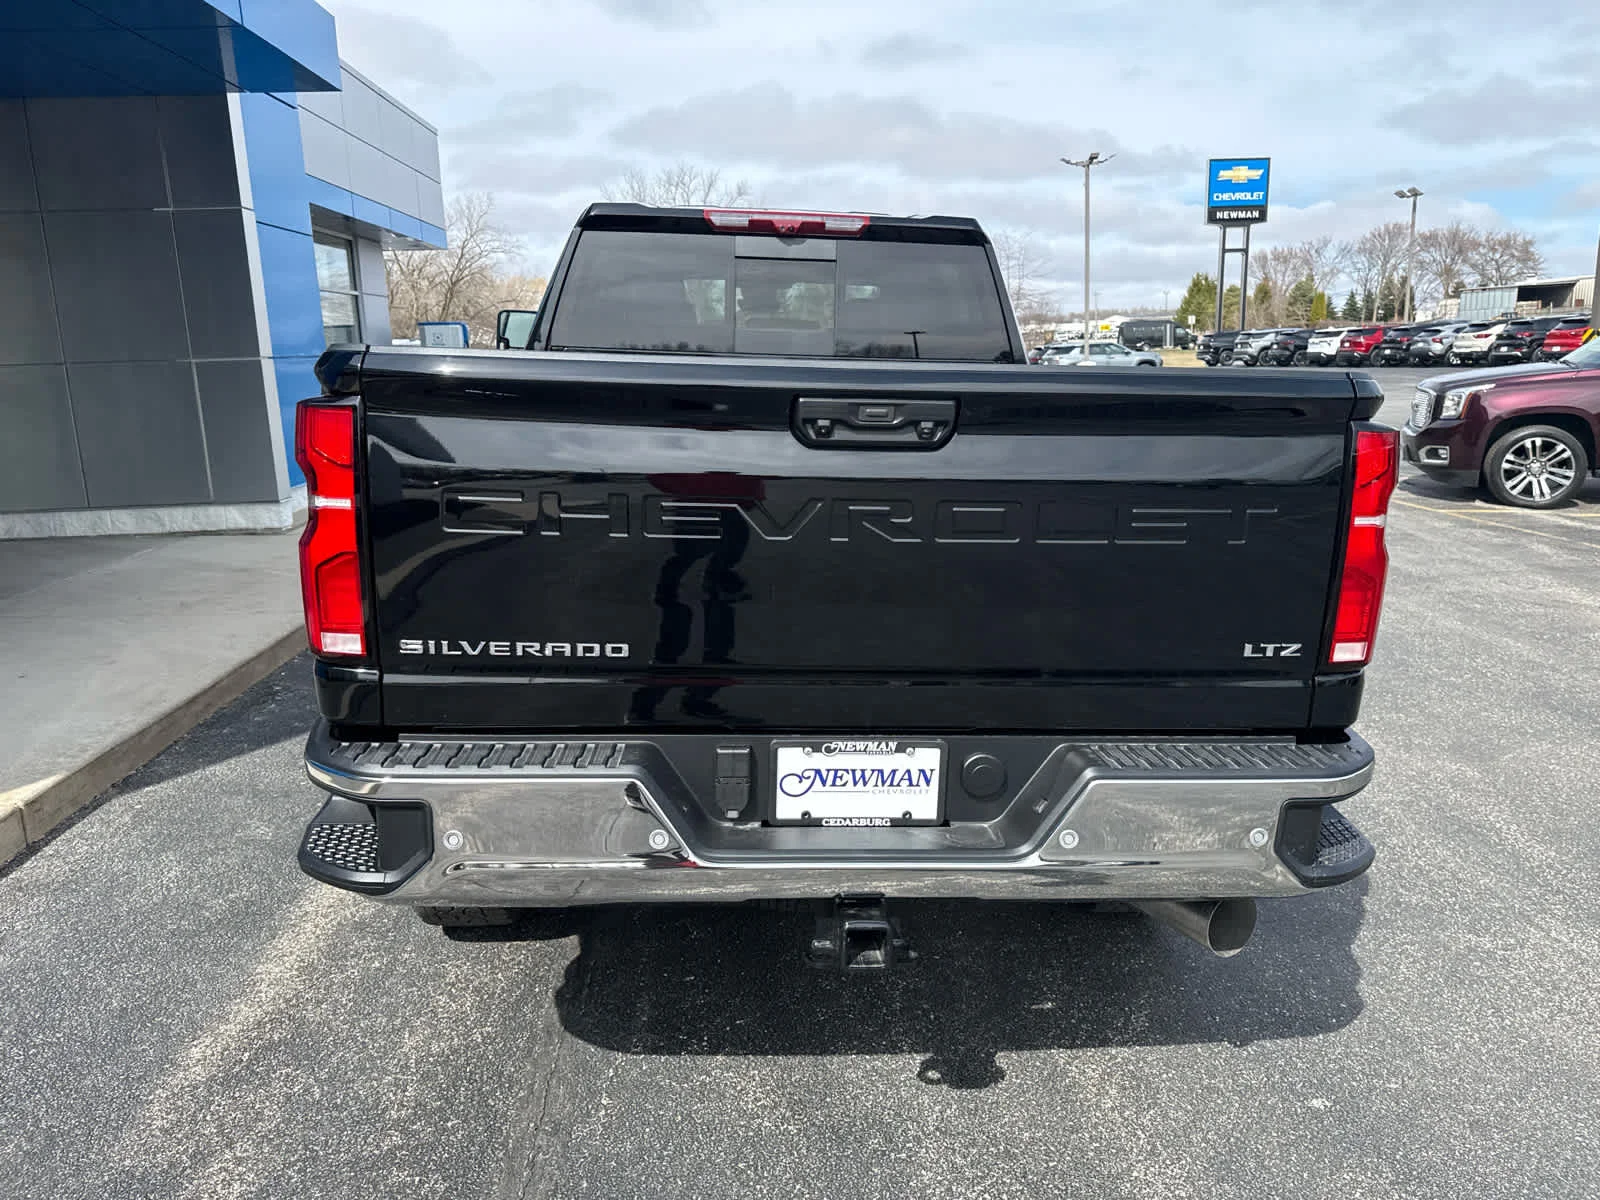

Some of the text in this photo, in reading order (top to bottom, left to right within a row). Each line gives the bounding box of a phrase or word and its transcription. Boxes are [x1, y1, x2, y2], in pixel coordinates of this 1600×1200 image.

[1213, 191, 1264, 200] CHEVROLET
[1216, 210, 1259, 219] NEWMAN
[440, 488, 1280, 545] CHEVROLET
[399, 639, 630, 658] SILVERADO
[1243, 643, 1303, 657] LTZ
[821, 741, 898, 757] NEWMAN
[779, 768, 935, 797] NEWMAN
[871, 788, 930, 796] CHEVROLET
[821, 817, 892, 827] CEDARBURG
